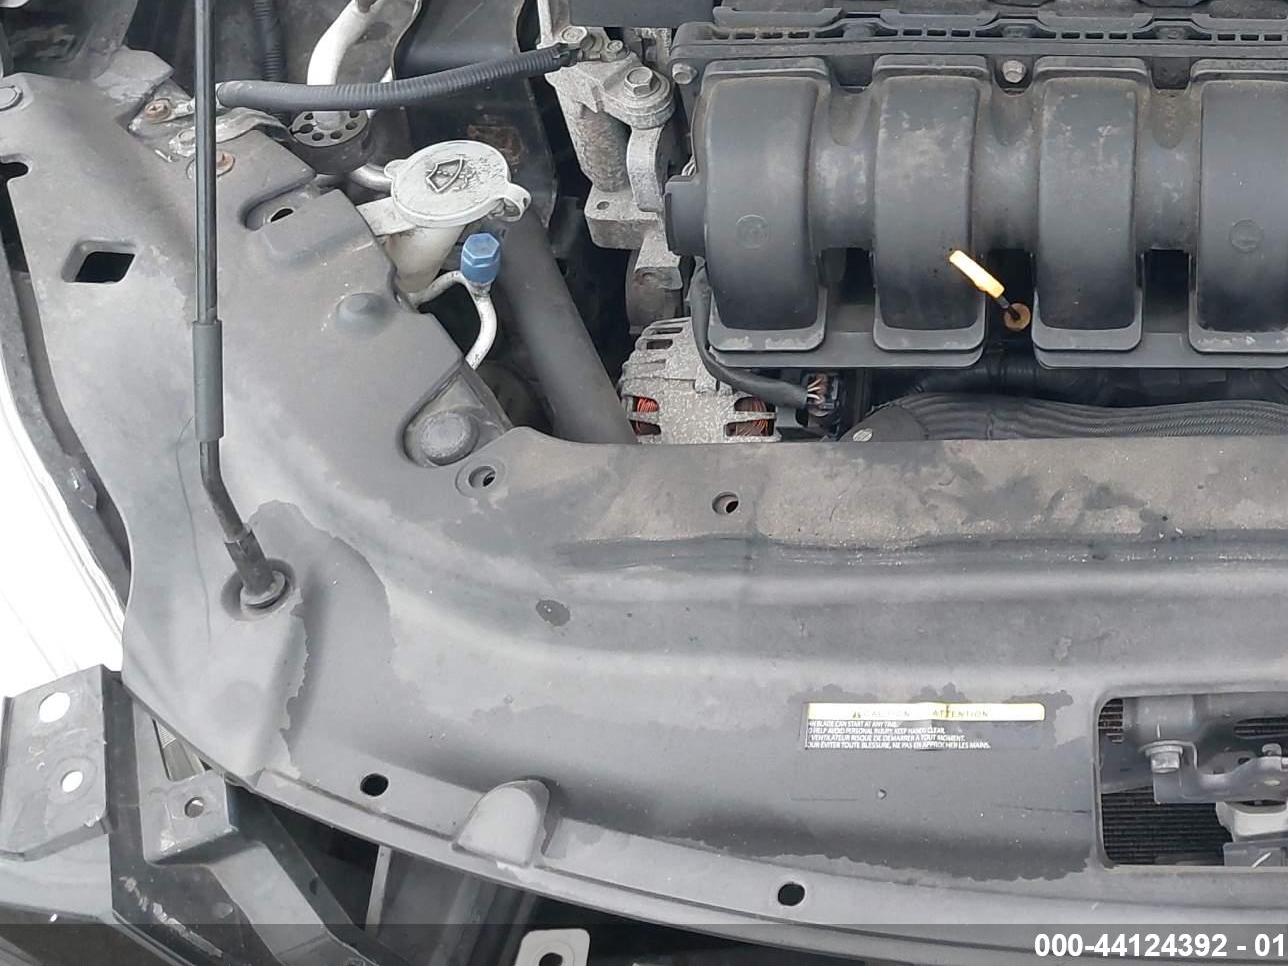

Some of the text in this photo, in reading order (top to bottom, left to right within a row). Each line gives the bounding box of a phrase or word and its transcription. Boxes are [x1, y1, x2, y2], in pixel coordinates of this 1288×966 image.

[871, 720, 885, 728] ANY
[845, 727, 873, 735] PERSONAL
[894, 727, 908, 735] KEEP
[811, 734, 851, 742] VENTILATEUR
[851, 734, 872, 742] RISQUE
[873, 734, 881, 742] DE
[920, 734, 937, 742] TOUT
[841, 741, 860, 749] TOUTE
[892, 741, 901, 749] NE
[901, 741, 913, 749] PAS
[958, 741, 969, 749] LES
